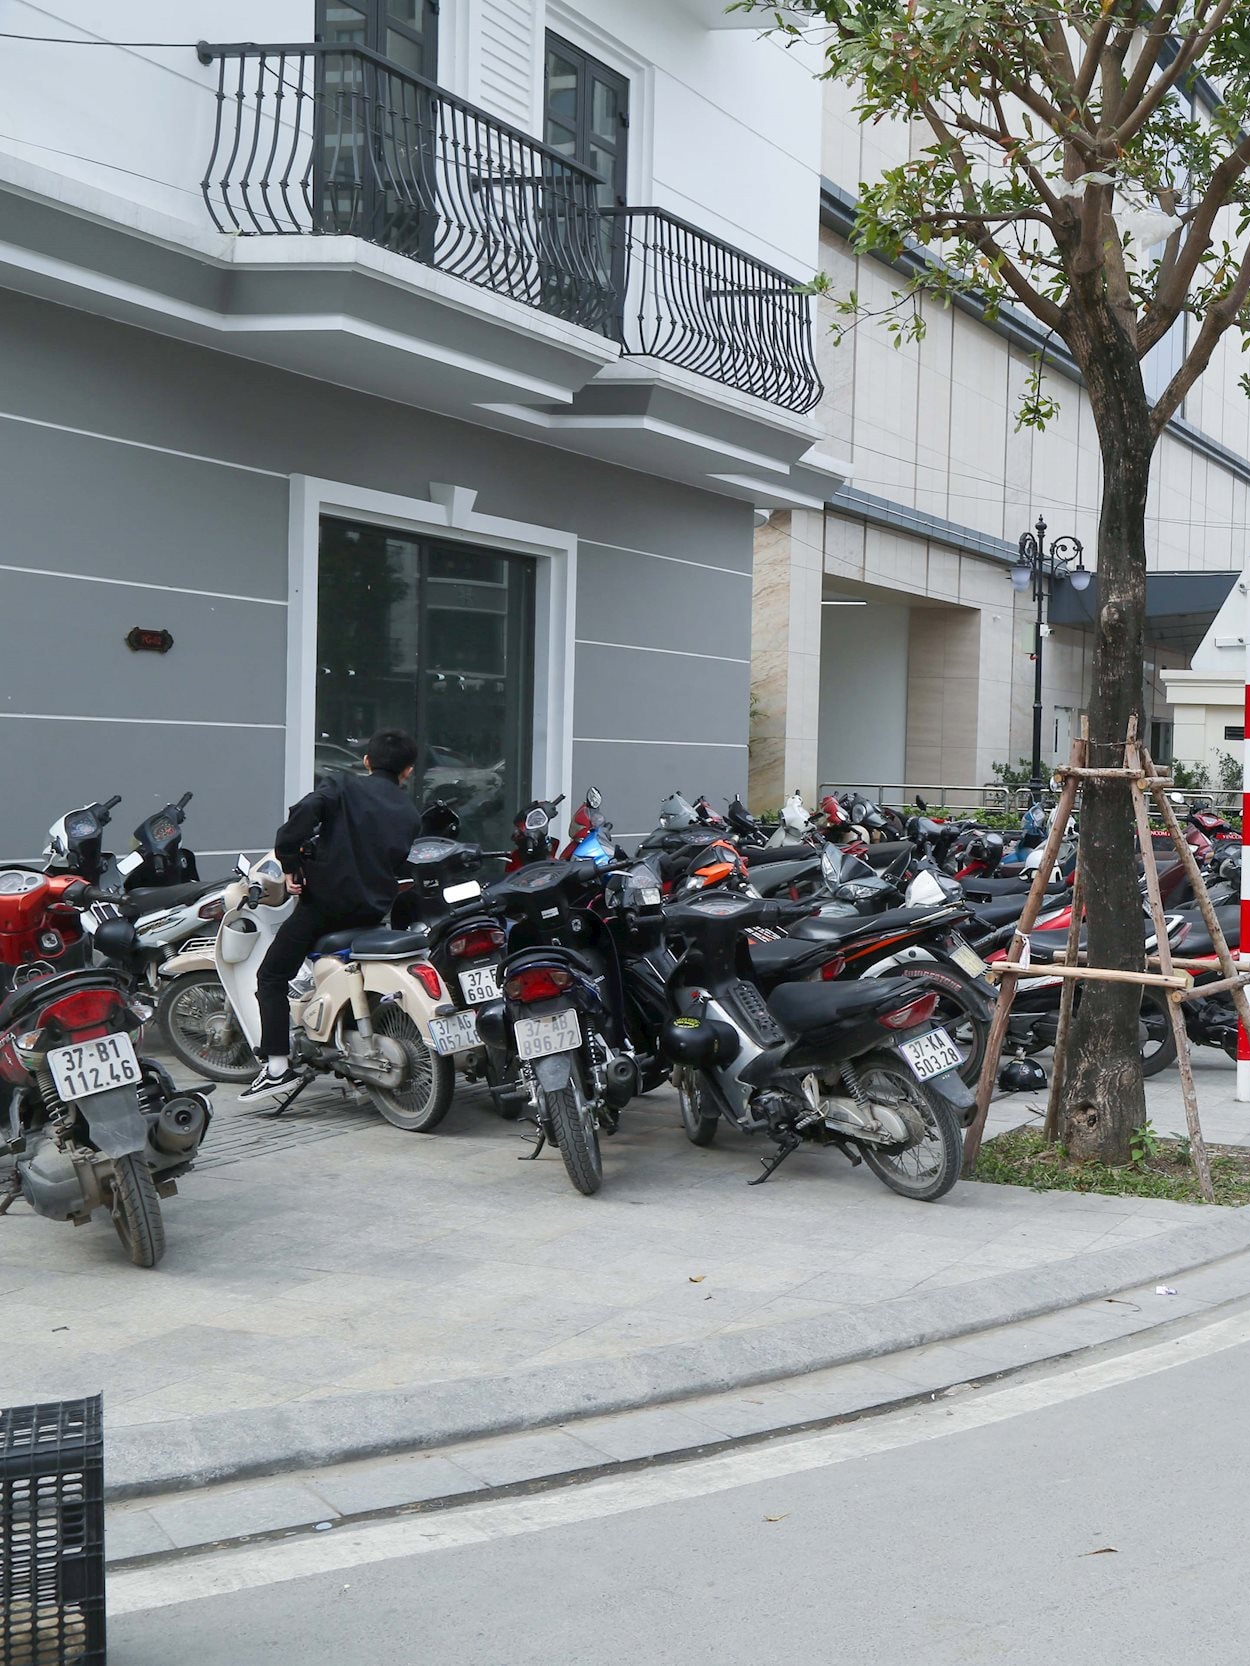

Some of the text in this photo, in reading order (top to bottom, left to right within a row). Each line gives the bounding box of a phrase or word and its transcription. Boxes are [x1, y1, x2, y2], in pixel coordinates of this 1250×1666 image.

[467, 985, 499, 1001] 690.
[436, 1014, 472, 1035] 37-AG
[525, 1014, 568, 1038] 37-AB
[62, 1039, 120, 1071] 37-B1
[523, 1030, 577, 1057] 896.72
[909, 1033, 946, 1059] 37-KA
[914, 1047, 959, 1078] 503.28
[64, 1059, 134, 1095] 112.46
